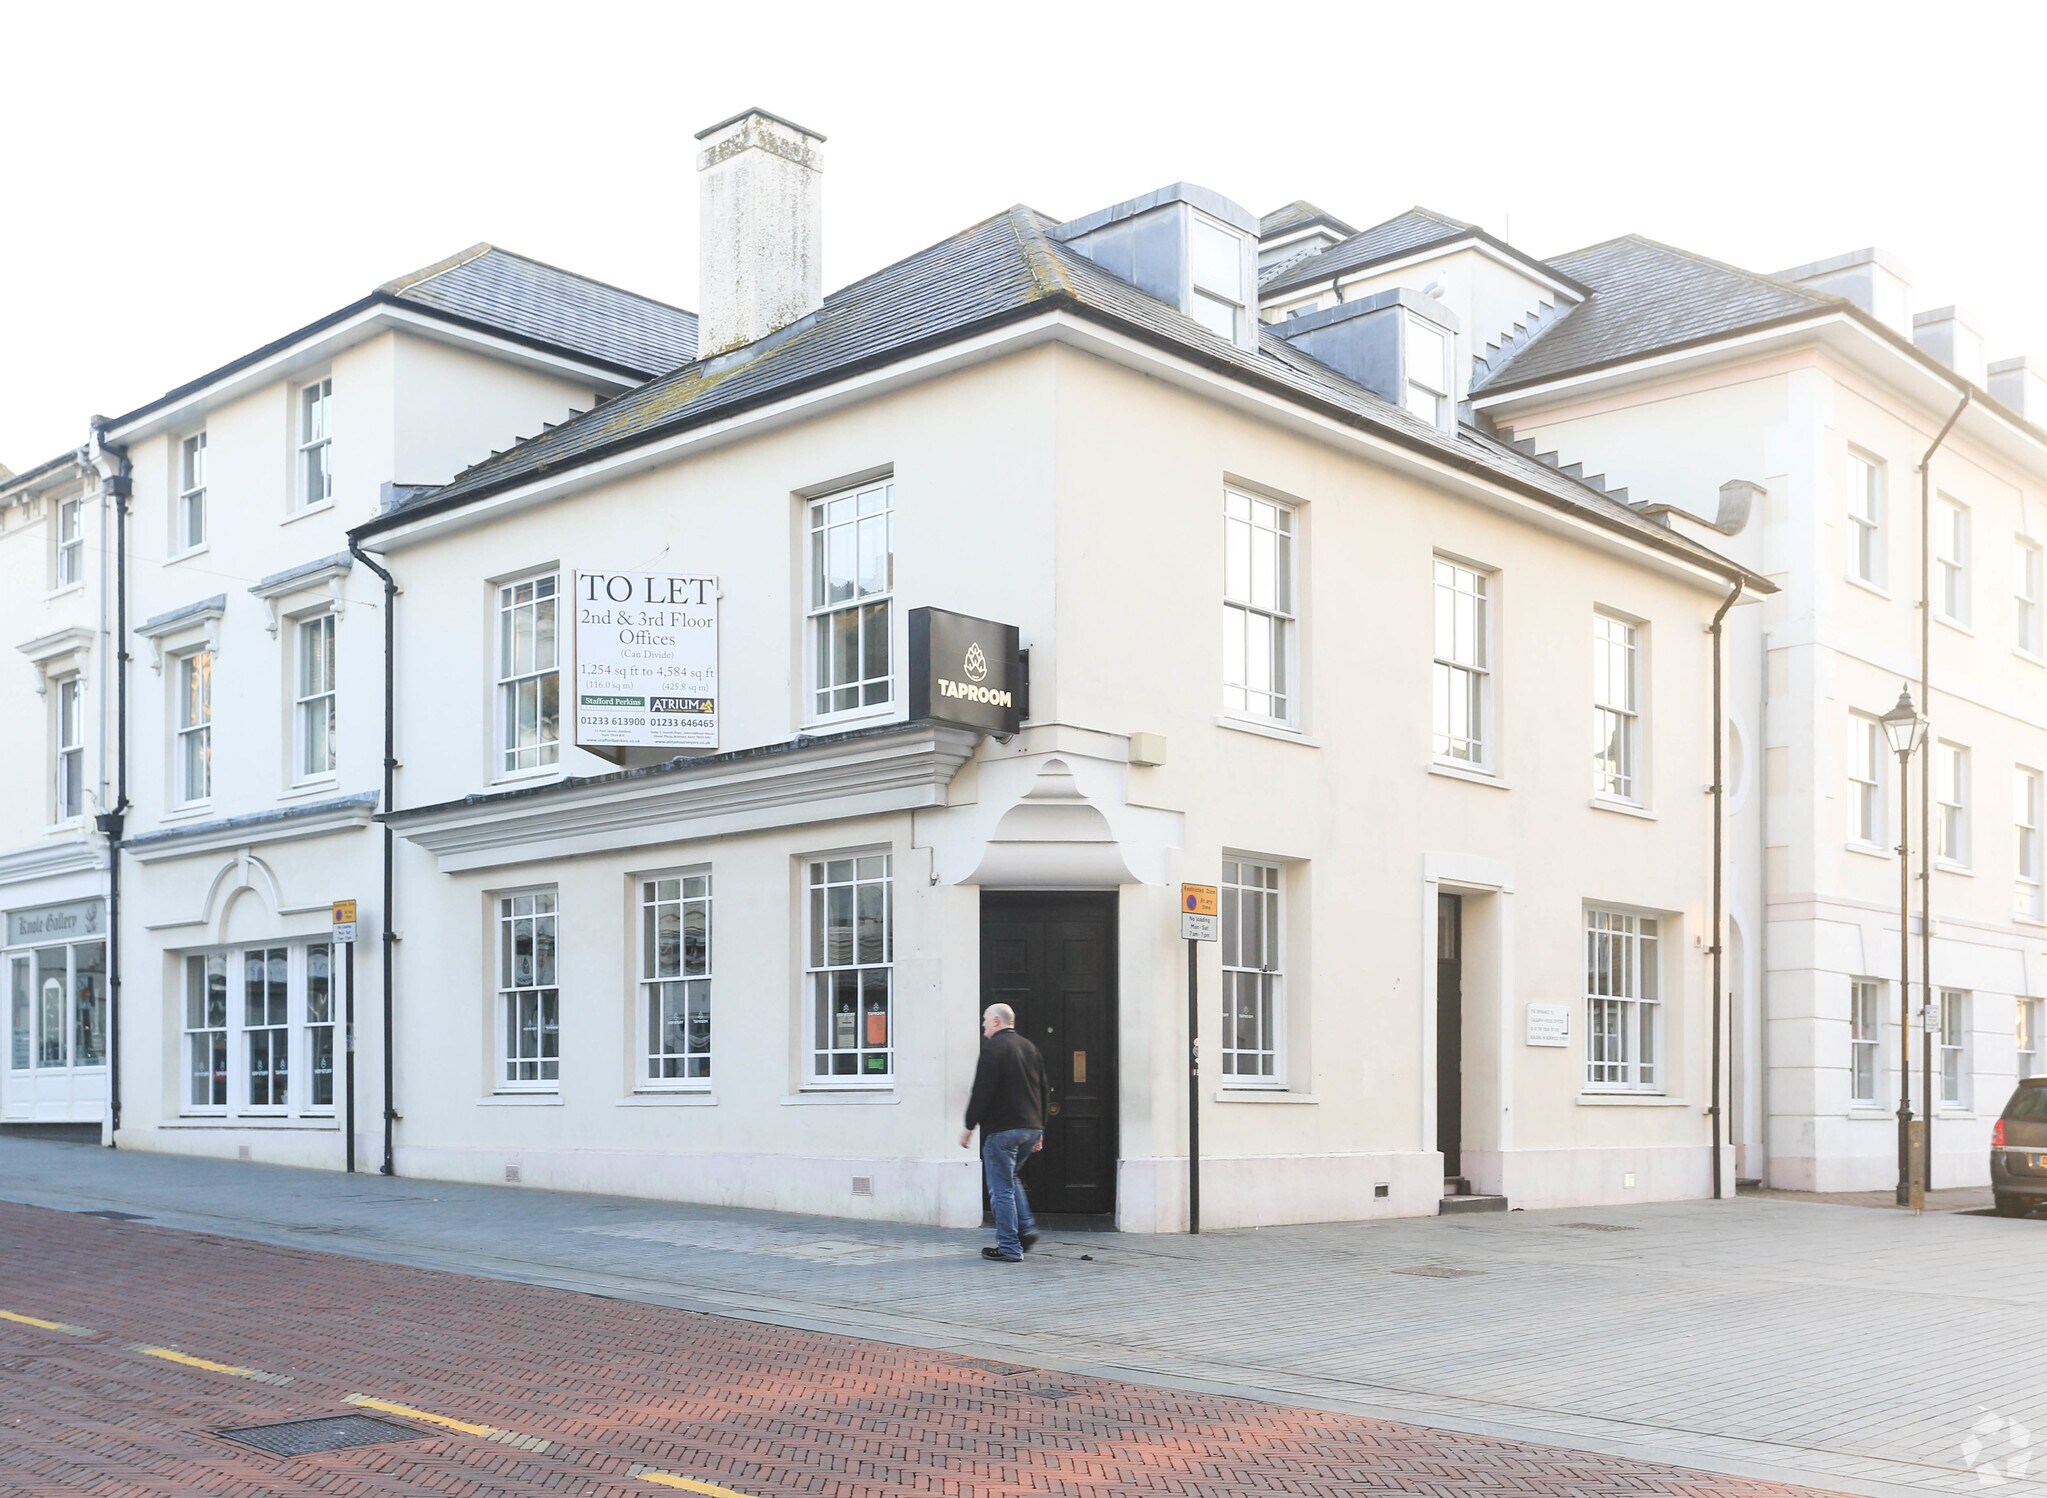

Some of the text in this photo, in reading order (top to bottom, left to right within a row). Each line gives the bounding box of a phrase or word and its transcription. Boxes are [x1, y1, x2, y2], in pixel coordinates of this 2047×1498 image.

[580, 574, 714, 605] TO LET
[581, 609, 714, 628] 2nd & 3rd Floor
[619, 629, 676, 646] Offices
[620, 649, 674, 660] (Can Divide)
[580, 664, 714, 682] 1,254 sq ft to 4,584 sq ft
[586, 680, 610, 690] (116.0
[662, 682, 686, 692] (425.8
[938, 678, 1012, 708] TAPROOM
[652, 698, 700, 712] ATRIUM
[580, 716, 645, 726] 01233 613900
[650, 718, 714, 728] 01233 646465
[19, 913, 77, 935] Knole Gallery
